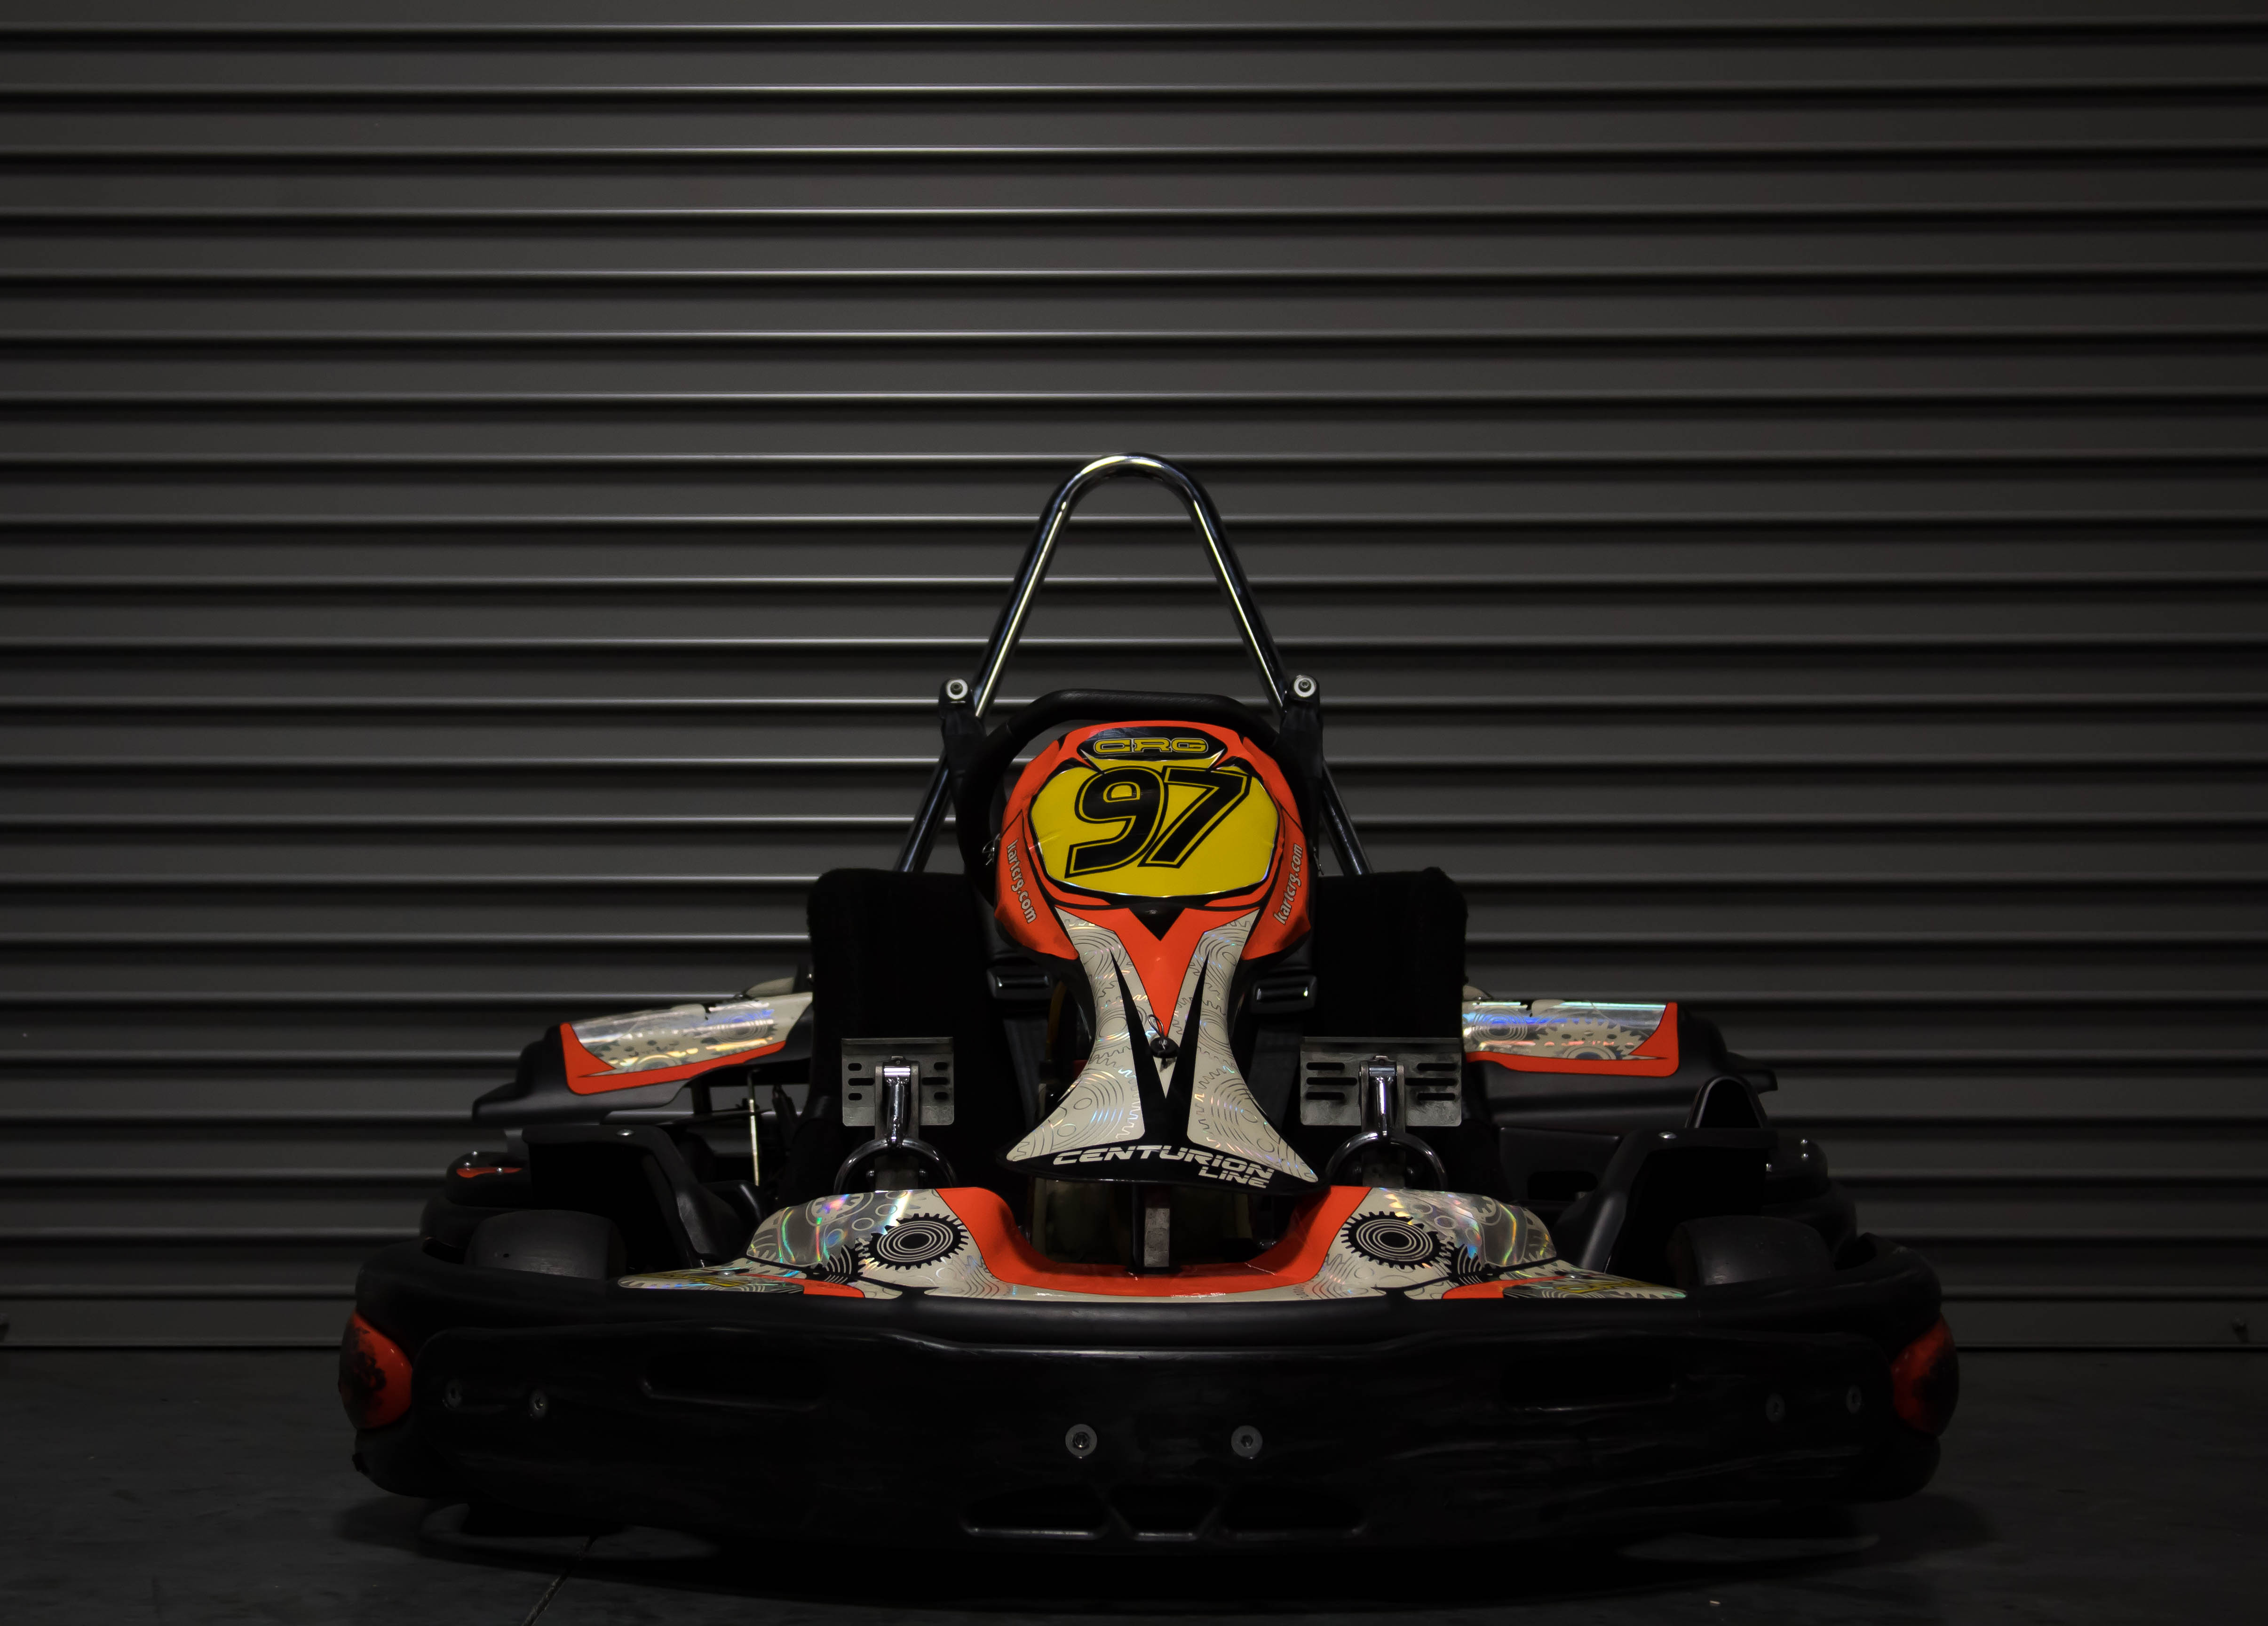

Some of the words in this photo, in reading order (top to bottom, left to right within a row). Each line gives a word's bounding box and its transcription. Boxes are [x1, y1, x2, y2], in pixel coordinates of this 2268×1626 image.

[1094, 737, 1209, 754] CRG
[1065, 765, 1252, 878] 97
[1274, 843, 1303, 925] kartcrg.com
[1053, 1145, 1275, 1180] CENTURION
[1198, 1166, 1270, 1189] LINE
